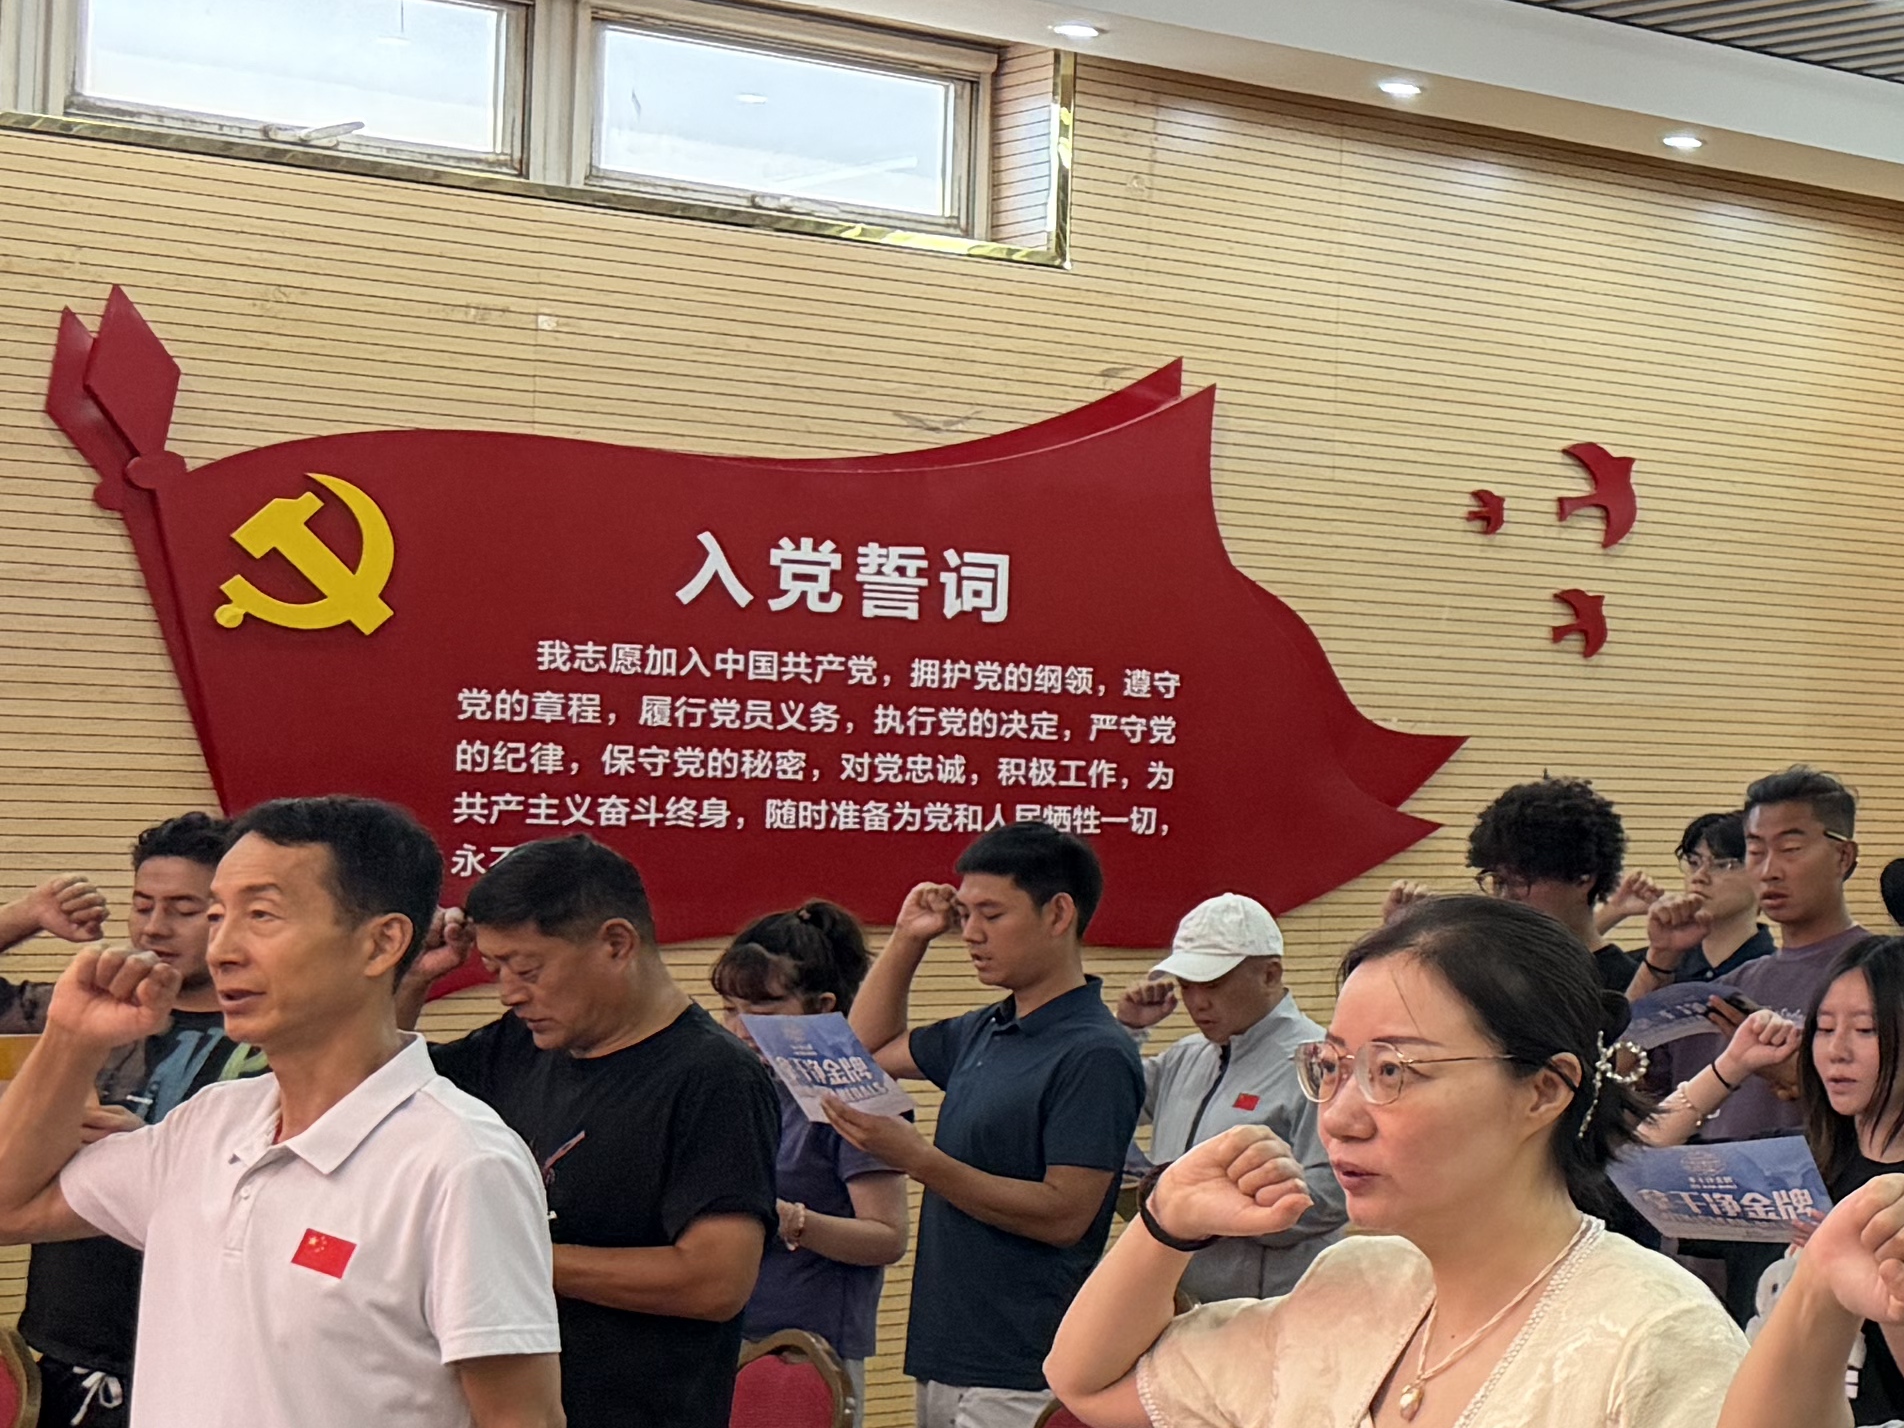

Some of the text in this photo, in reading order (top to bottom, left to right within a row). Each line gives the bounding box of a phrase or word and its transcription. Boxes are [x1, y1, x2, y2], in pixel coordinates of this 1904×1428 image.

[676, 531, 1009, 622] 入党誓词
[537, 639, 1181, 699] 我志愿加入中国共产党，拥护党的纲领，遵守
[457, 688, 1177, 745] 党的章程，履行党员义务，执行党的决定，严守党
[455, 739, 1174, 790] 的纪律，保守党的秘密，对党忠诚，积极工作，为
